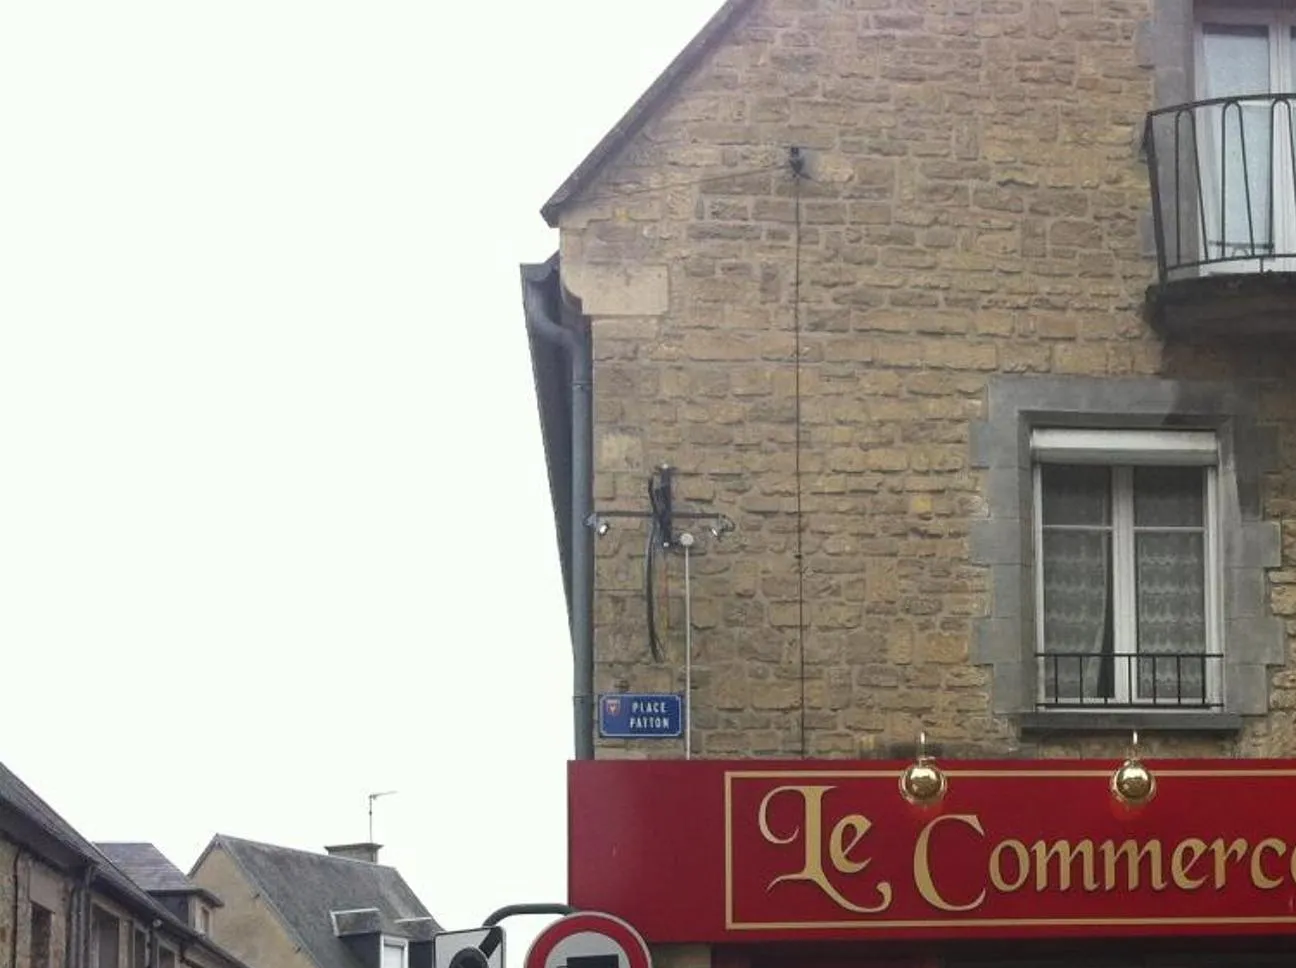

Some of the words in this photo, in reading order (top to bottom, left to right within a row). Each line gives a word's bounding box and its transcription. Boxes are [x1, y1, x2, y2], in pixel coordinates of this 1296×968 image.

[631, 701, 669, 714] PLACE
[629, 717, 670, 729] PATTON
[757, 784, 893, 913] Le
